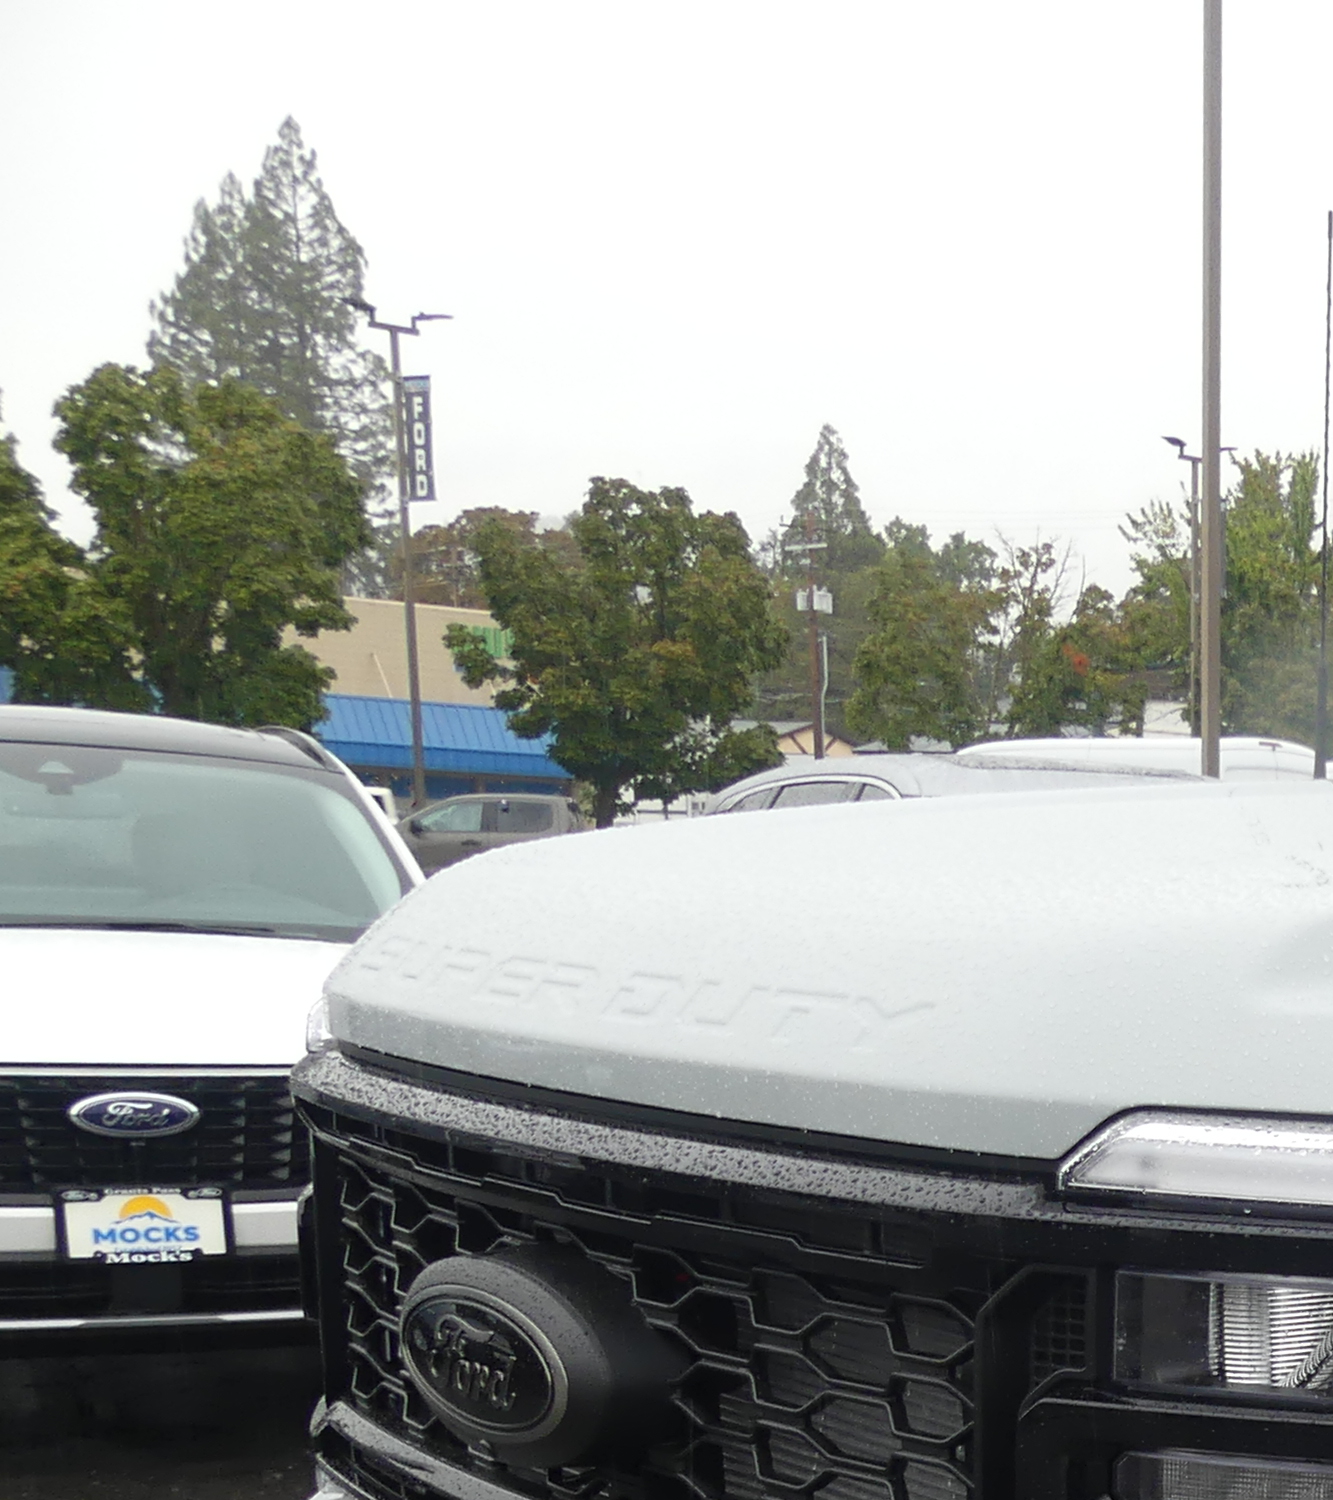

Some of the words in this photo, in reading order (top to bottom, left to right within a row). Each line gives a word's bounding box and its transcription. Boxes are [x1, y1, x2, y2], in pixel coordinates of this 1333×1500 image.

[412, 396, 428, 498] FORD
[600, 970, 936, 1053] DUTY
[101, 1101, 171, 1127] Ford
[92, 1225, 201, 1245] MOCKS
[105, 1250, 194, 1265] Mock's
